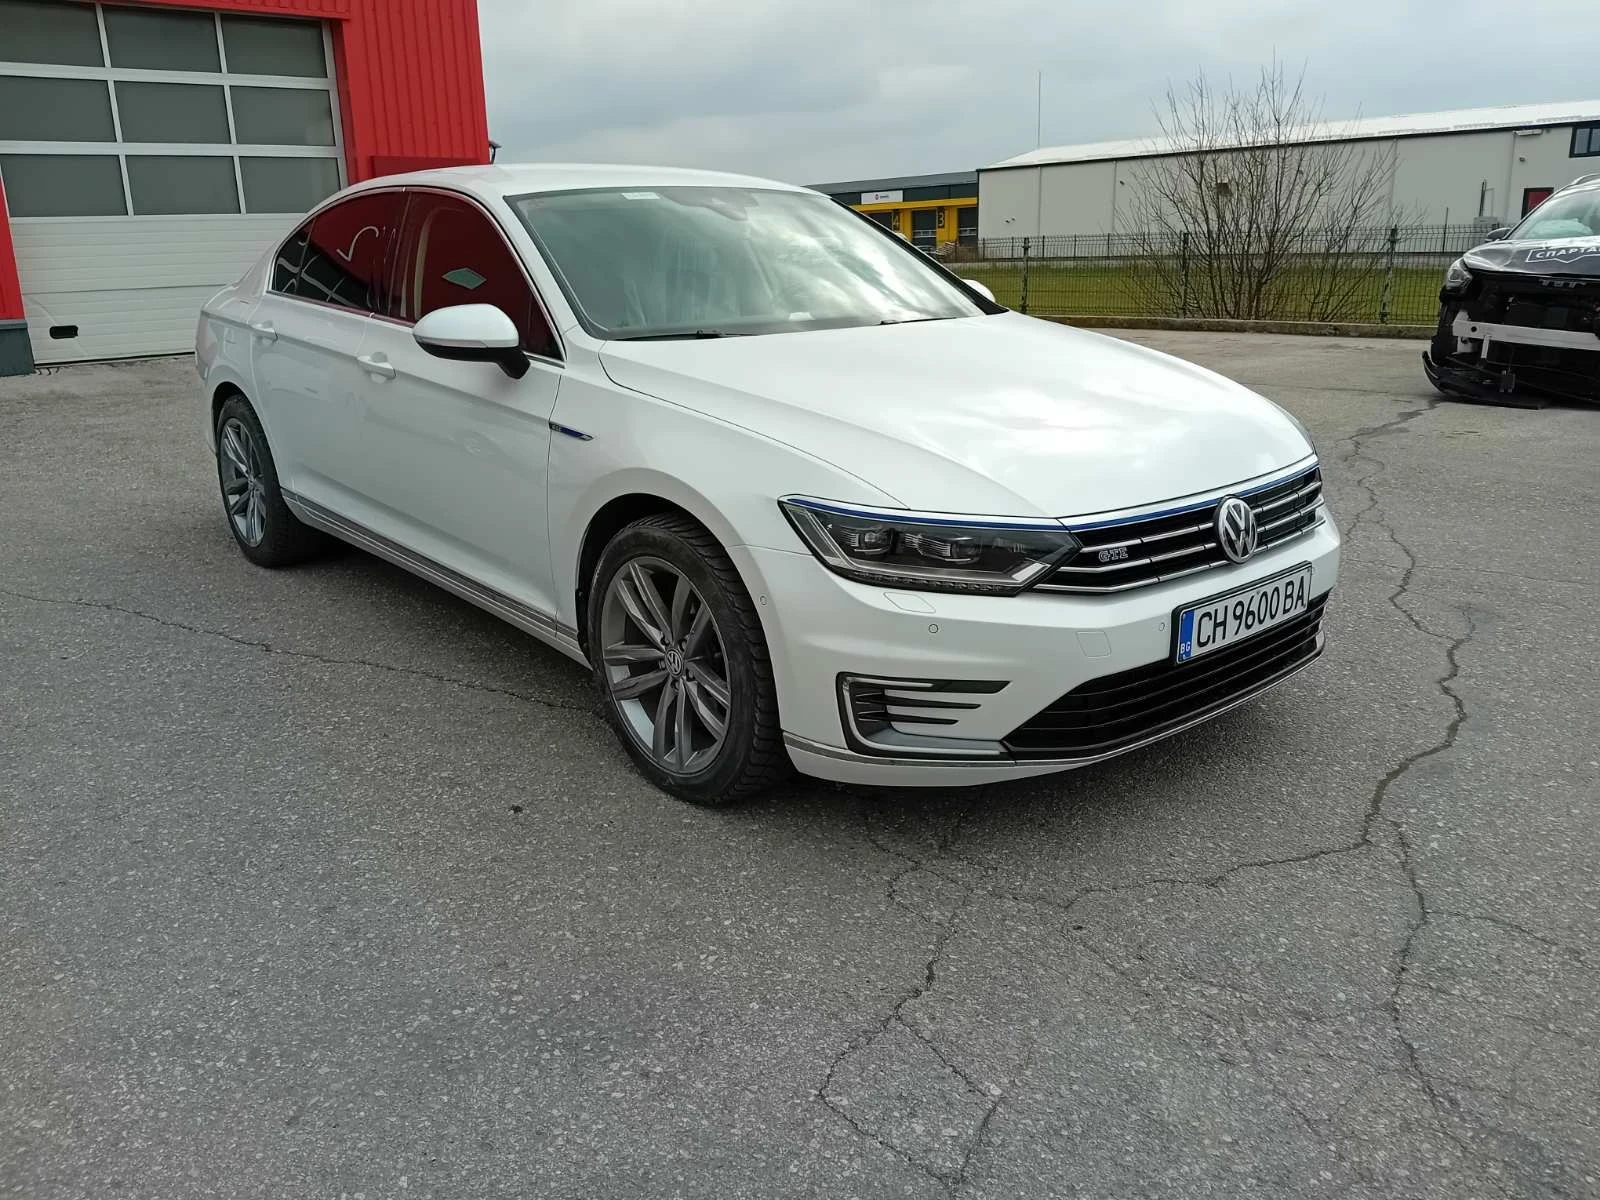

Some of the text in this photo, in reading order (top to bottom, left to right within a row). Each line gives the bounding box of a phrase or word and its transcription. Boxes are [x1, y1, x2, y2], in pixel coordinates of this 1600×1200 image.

[938, 212, 945, 227] 3
[1536, 246, 1600, 258] СПАРТА
[1098, 546, 1129, 563] GTE
[1180, 641, 1191, 654] BG
